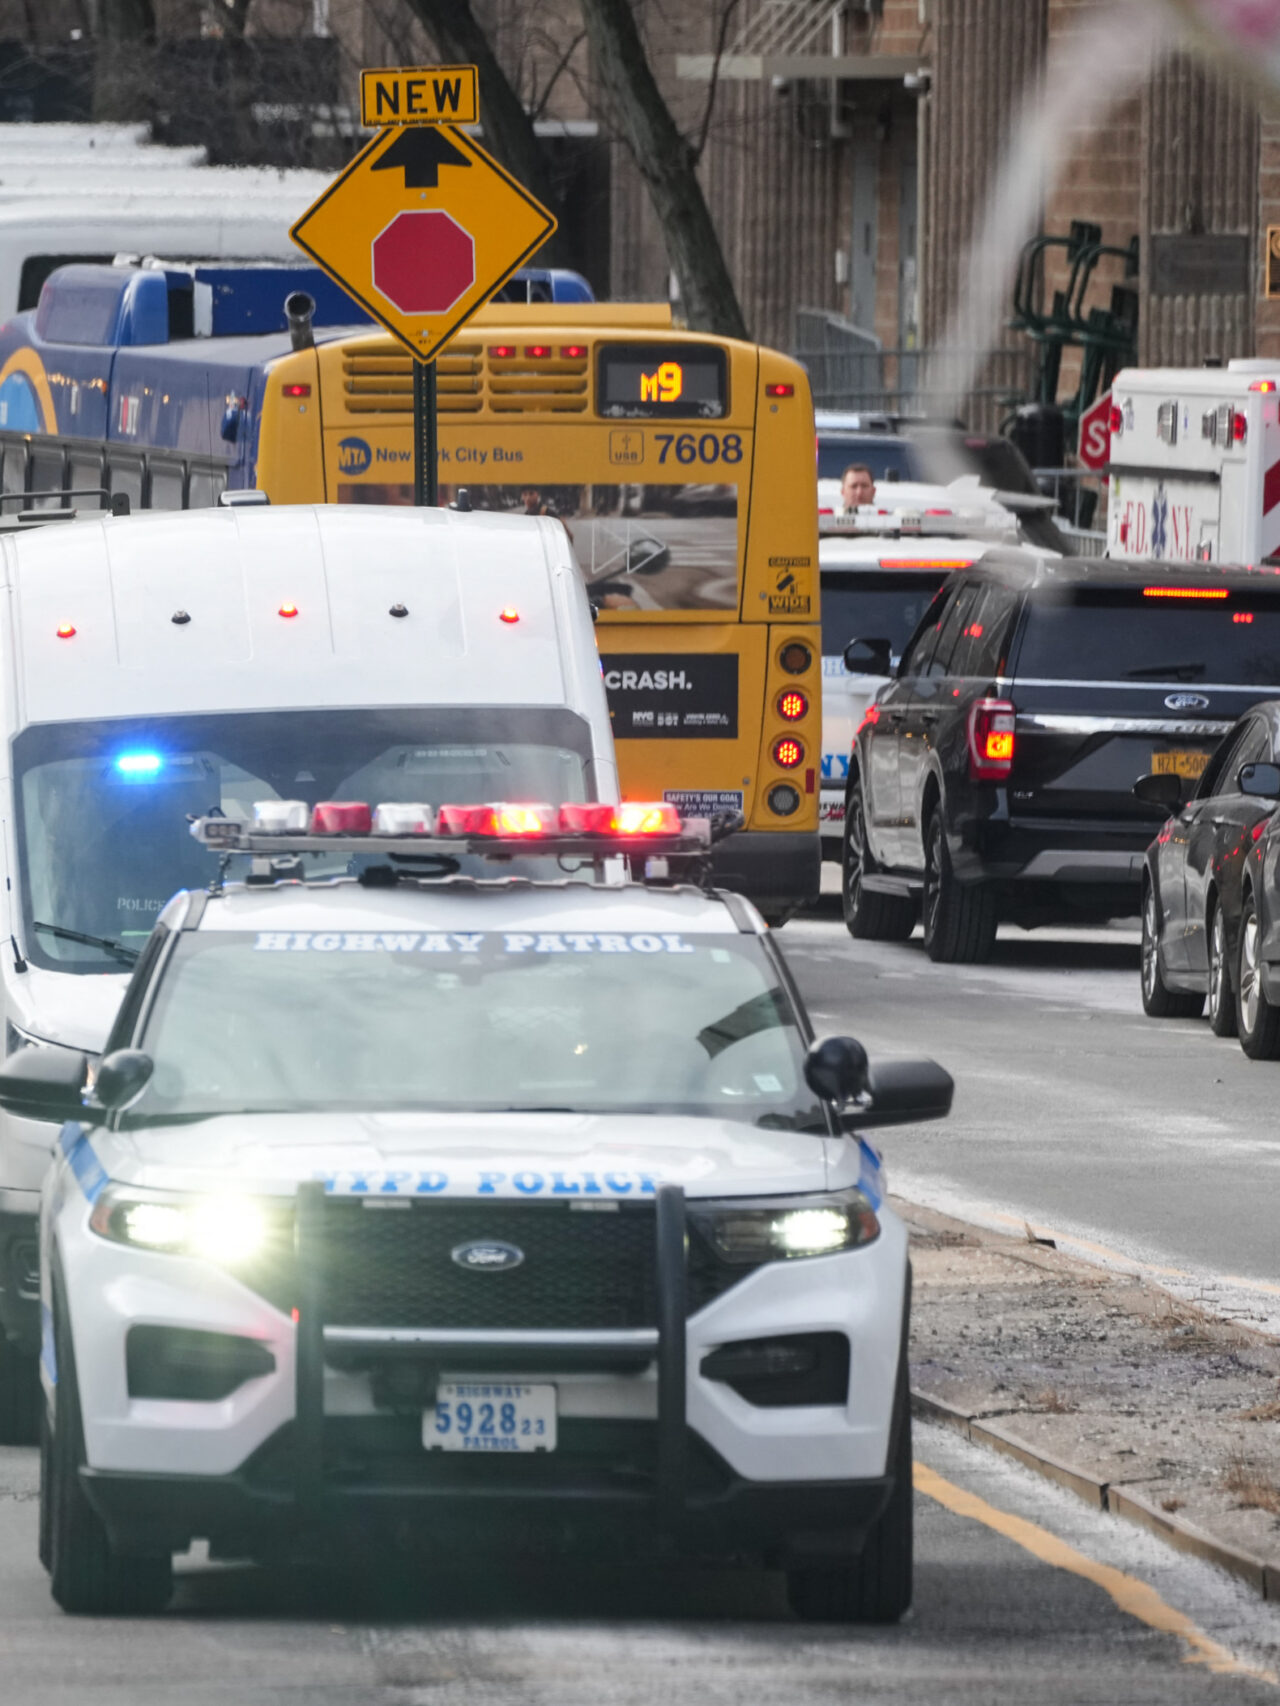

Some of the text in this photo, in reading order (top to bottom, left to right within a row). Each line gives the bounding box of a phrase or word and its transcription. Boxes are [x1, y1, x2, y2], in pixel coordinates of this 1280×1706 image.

[376, 78, 461, 115] NEW
[640, 362, 683, 402] M9
[376, 448, 411, 462] New
[455, 448, 488, 464] City
[493, 448, 524, 462] Bus
[615, 451, 638, 460] USB
[654, 433, 743, 464] 7608
[605, 671, 693, 690] CRASH.
[117, 897, 166, 912] POLICE
[253, 932, 694, 954] HIGHWAY PATROL
[456, 1386, 521, 1398] HIGHWAY
[435, 1402, 545, 1435] 5928 23
[464, 1437, 519, 1449] PATROL
